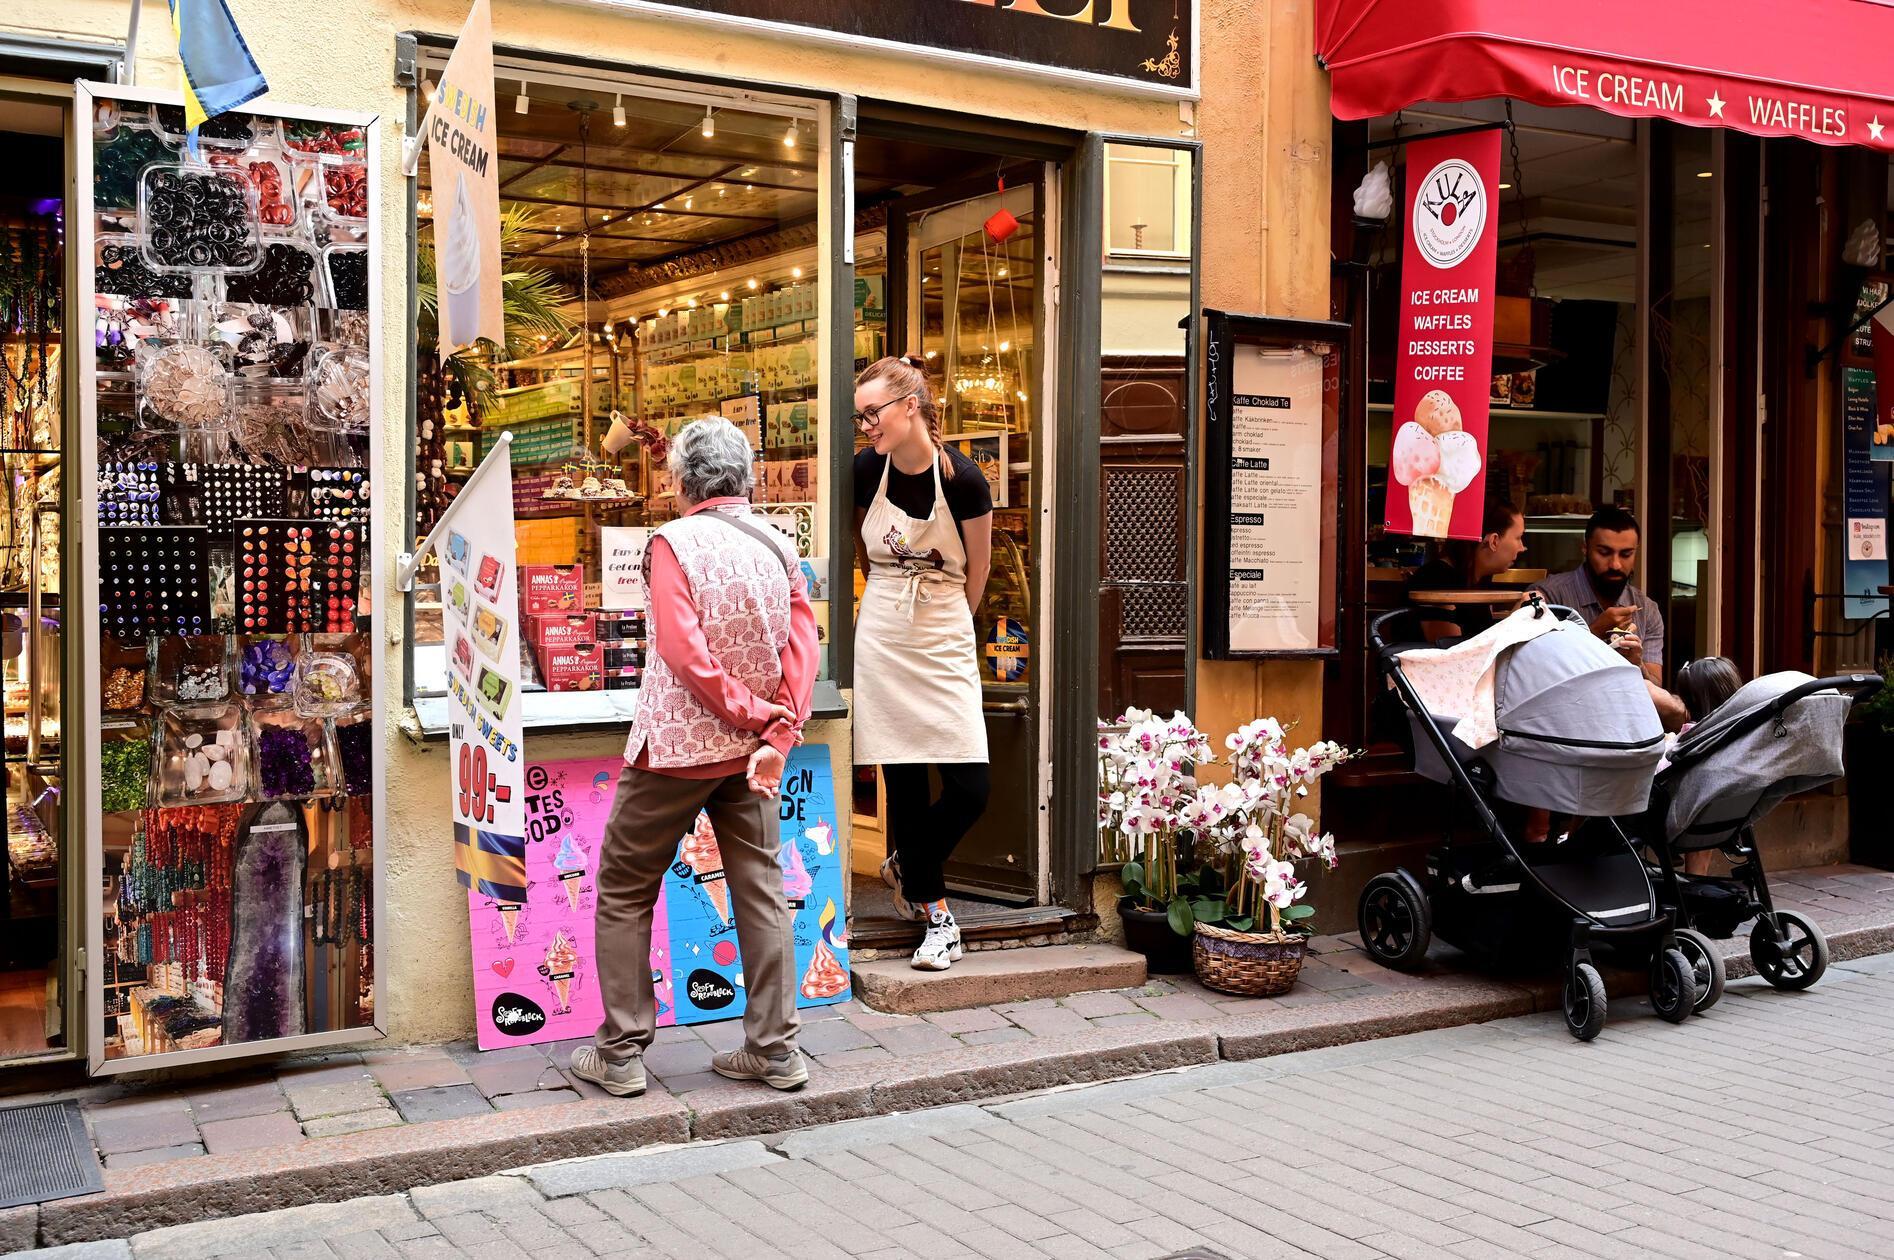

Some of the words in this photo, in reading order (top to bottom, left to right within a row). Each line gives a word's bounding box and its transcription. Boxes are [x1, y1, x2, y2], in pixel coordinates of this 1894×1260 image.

[438, 79, 487, 132] SWEDISH
[1552, 65, 1590, 98] ICE
[1597, 73, 1683, 112] CREAM
[1748, 96, 1846, 136] WAFFLES
[431, 114, 450, 148] ICE
[450, 128, 488, 178] CREAM
[1411, 291, 1430, 304] ICE
[1433, 288, 1479, 304] CREAM
[1414, 314, 1472, 330] WAFFLES
[1409, 340, 1475, 356] DESSERTS
[1414, 366, 1464, 380] COFFEE
[1252, 397, 1279, 407] Choklad
[1280, 398, 1289, 408] Te
[1250, 460, 1267, 469] Latte
[1231, 514, 1262, 524] Espresso
[532, 575, 553, 584] ANNAS
[617, 576, 638, 584] free
[1230, 570, 1261, 578] Especiale
[545, 626, 566, 636] ANNAS
[553, 656, 573, 665] ANNAS
[448, 671, 477, 723] SWEDISH
[476, 713, 518, 762] SWEETS
[452, 723, 464, 740] ONLY
[459, 742, 512, 824] 99:-
[786, 768, 813, 795] ON
[524, 790, 564, 814] TES
[780, 794, 806, 821] DE
[701, 872, 725, 882] CARAMEL
